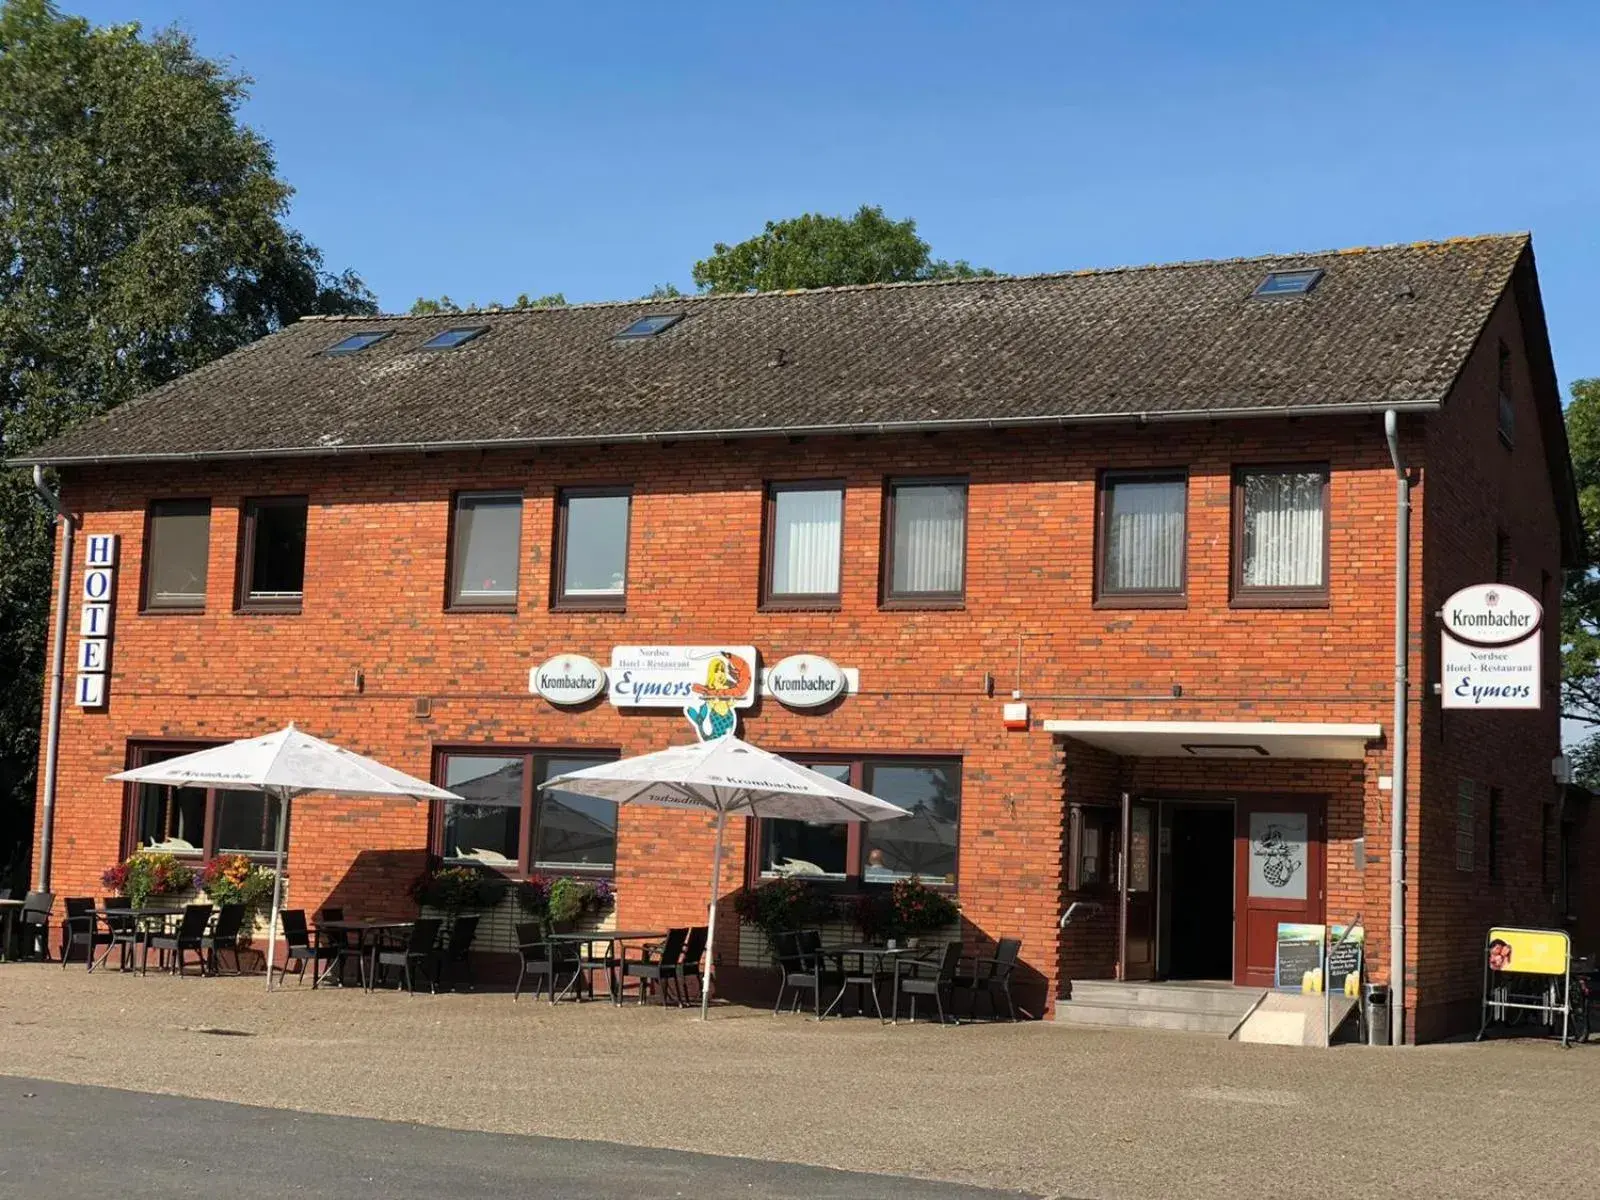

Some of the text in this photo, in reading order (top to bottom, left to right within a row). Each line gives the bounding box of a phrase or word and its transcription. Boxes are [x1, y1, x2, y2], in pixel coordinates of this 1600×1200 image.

[80, 537, 110, 703] HOTEL
[1453, 609, 1531, 627] Krombacher
[639, 648, 670, 657] Nordsee
[1470, 651, 1509, 661] Nordsee
[619, 659, 640, 668] Hotel
[648, 659, 690, 668] Restaurant
[1446, 663, 1472, 673] Hotel
[1480, 663, 1533, 673] Restaurant
[541, 673, 597, 689] Krombacher
[615, 670, 692, 703] Eymers
[774, 675, 836, 691] Krombacher
[1454, 676, 1531, 704] Eymers
[726, 776, 809, 791] Krombacher
